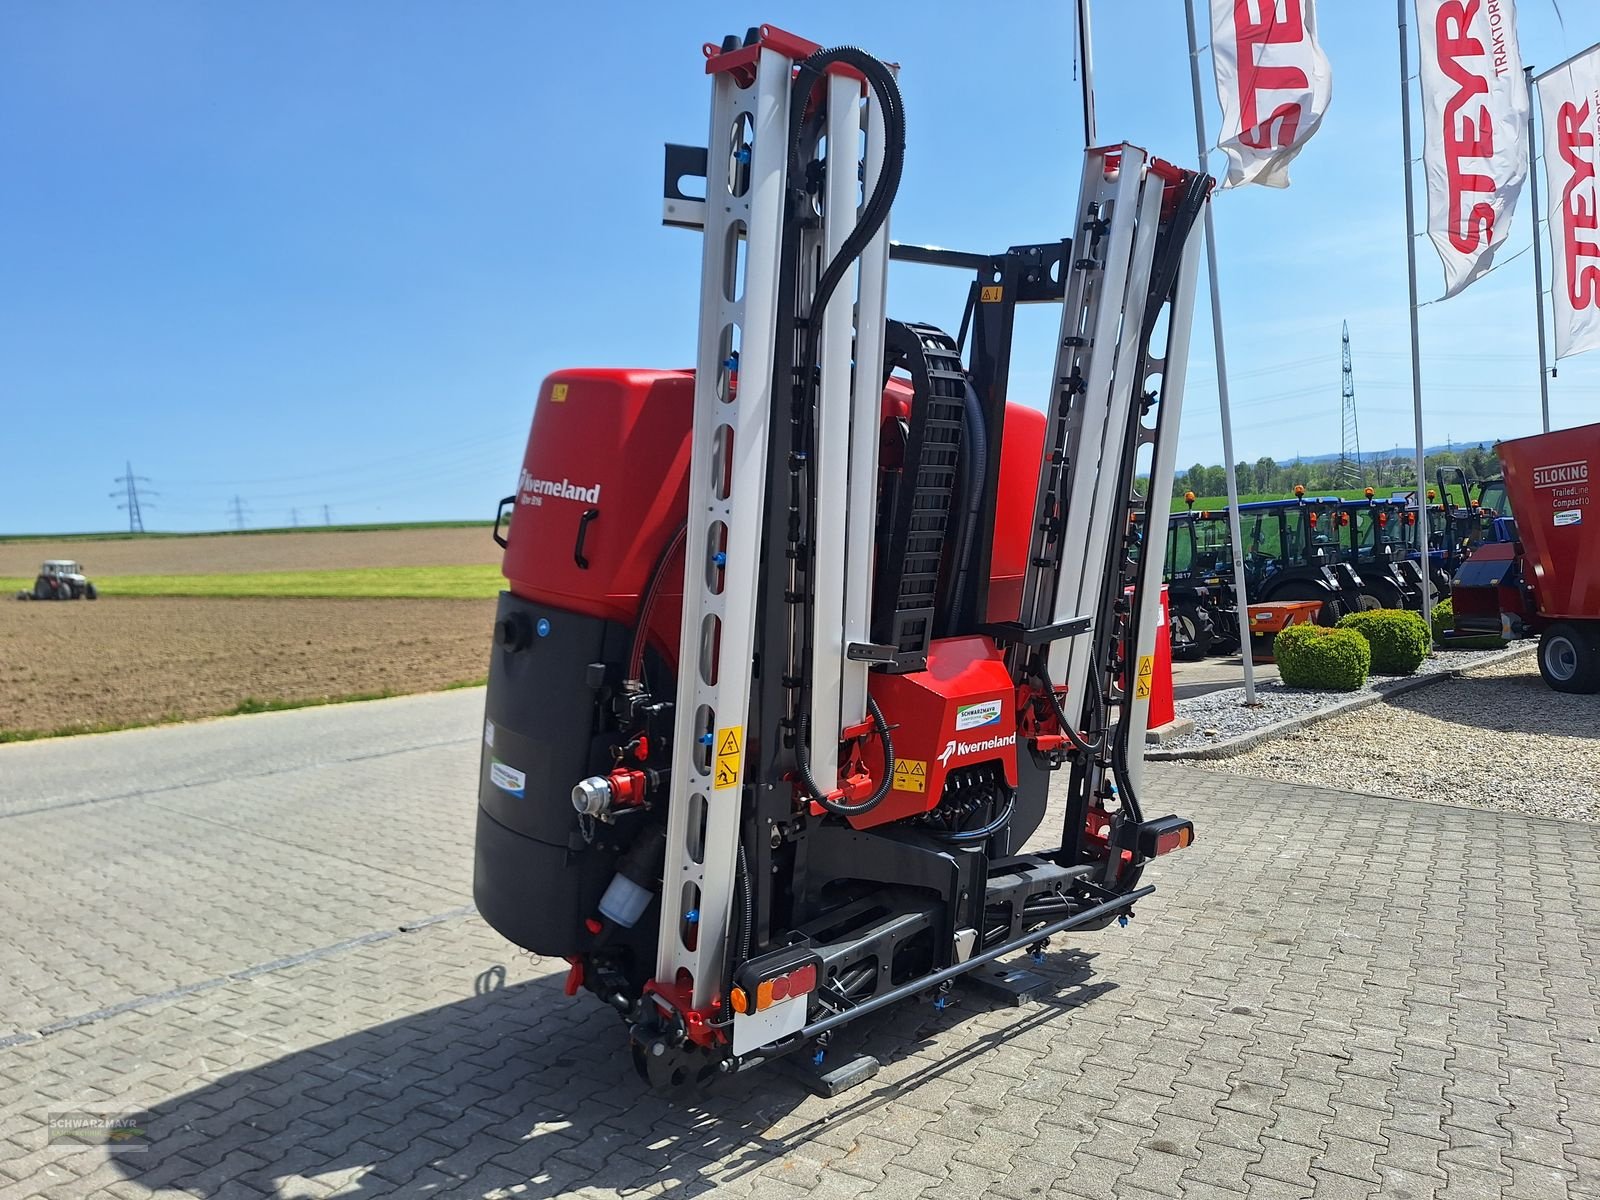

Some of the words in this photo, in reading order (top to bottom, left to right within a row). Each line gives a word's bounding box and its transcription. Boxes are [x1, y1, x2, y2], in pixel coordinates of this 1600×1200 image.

[1487, 0, 1509, 78] TRAKTOR
[1435, 0, 1497, 255] STEYR
[1557, 96, 1600, 310] STEYR
[523, 473, 601, 504] Kverneland
[1533, 465, 1588, 485] SILOKING
[961, 706, 996, 718] SCHWARZMAYR
[957, 731, 1017, 756] Kverneland
